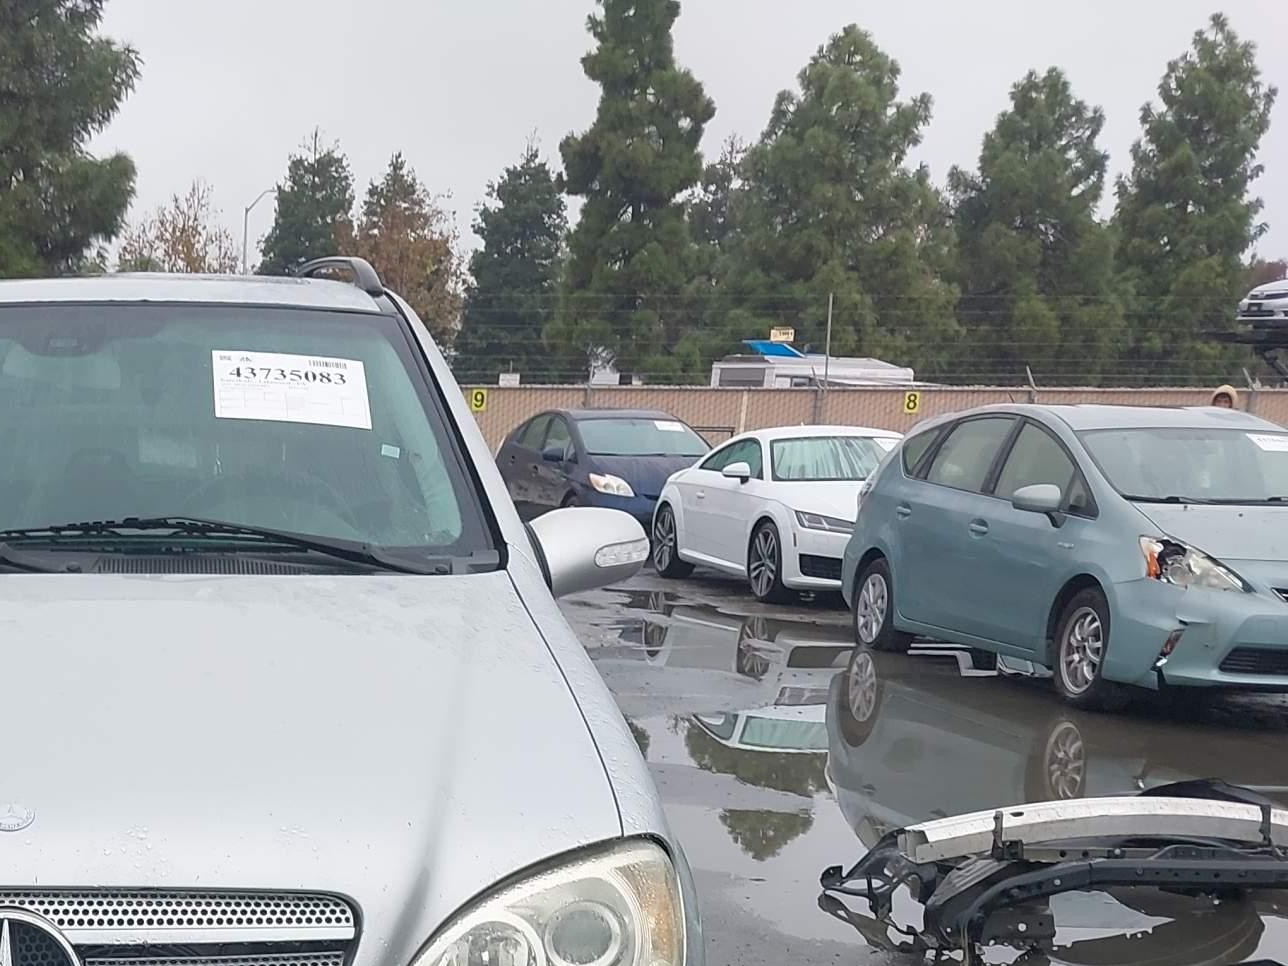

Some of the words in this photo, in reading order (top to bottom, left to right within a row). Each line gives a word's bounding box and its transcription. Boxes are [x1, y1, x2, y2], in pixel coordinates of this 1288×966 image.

[228, 366, 347, 386] 43735083
[474, 391, 485, 408] 9
[906, 393, 918, 410] 8
